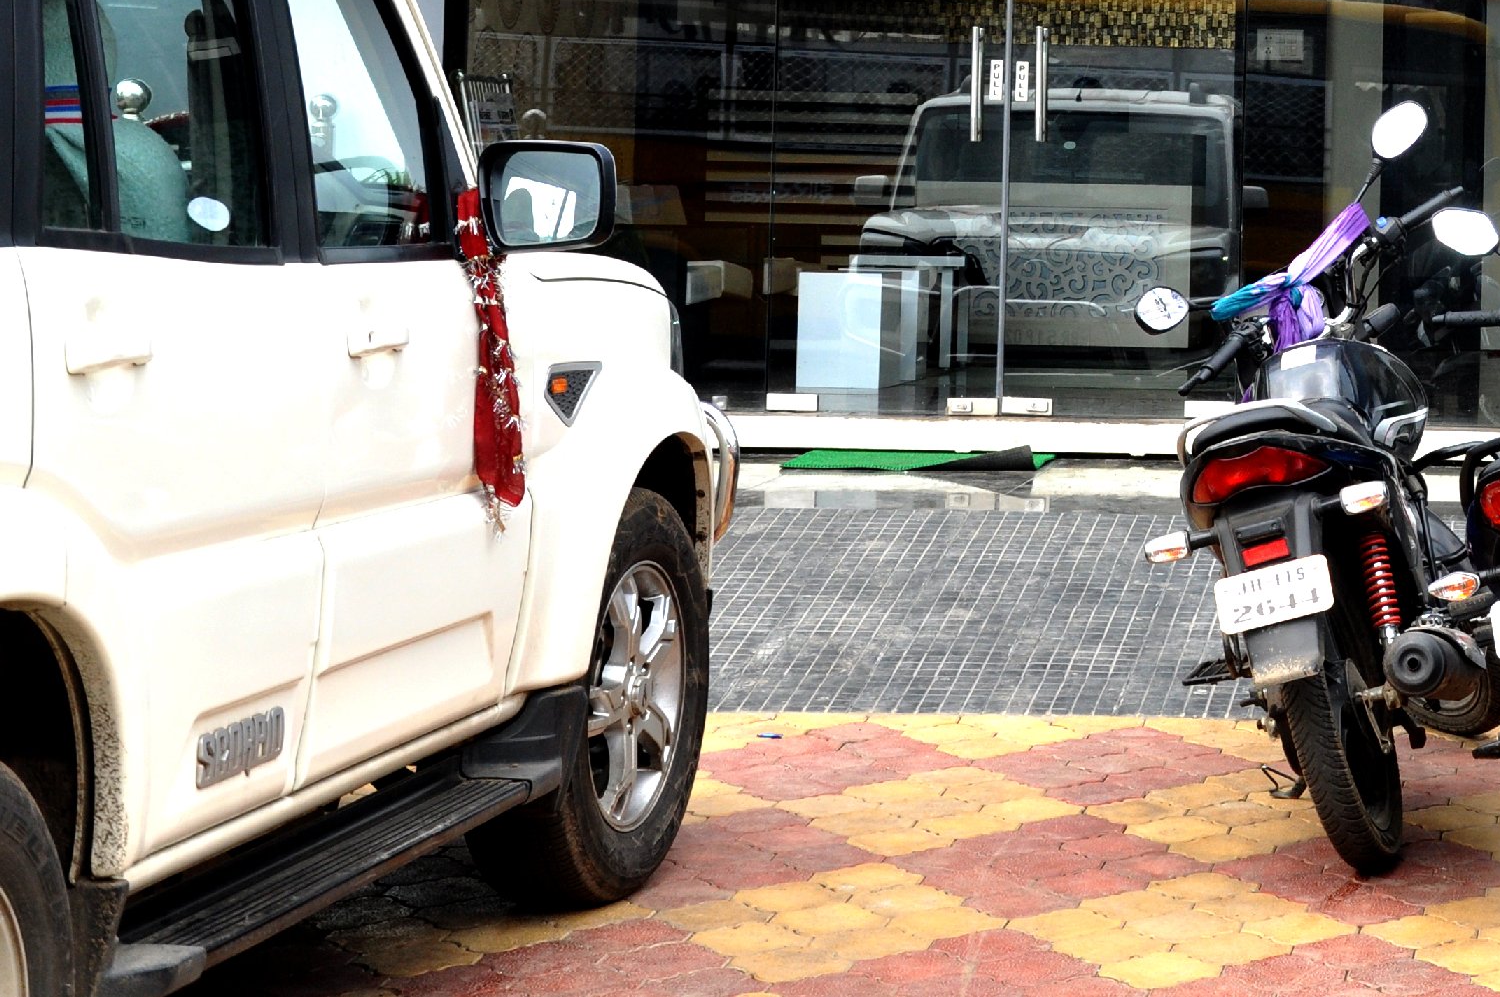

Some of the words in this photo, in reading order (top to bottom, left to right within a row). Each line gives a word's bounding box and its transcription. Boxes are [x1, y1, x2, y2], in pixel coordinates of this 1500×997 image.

[993, 64, 1001, 95] PULL
[1018, 65, 1026, 98] PULL
[196, 706, 285, 790] SCORPIO
